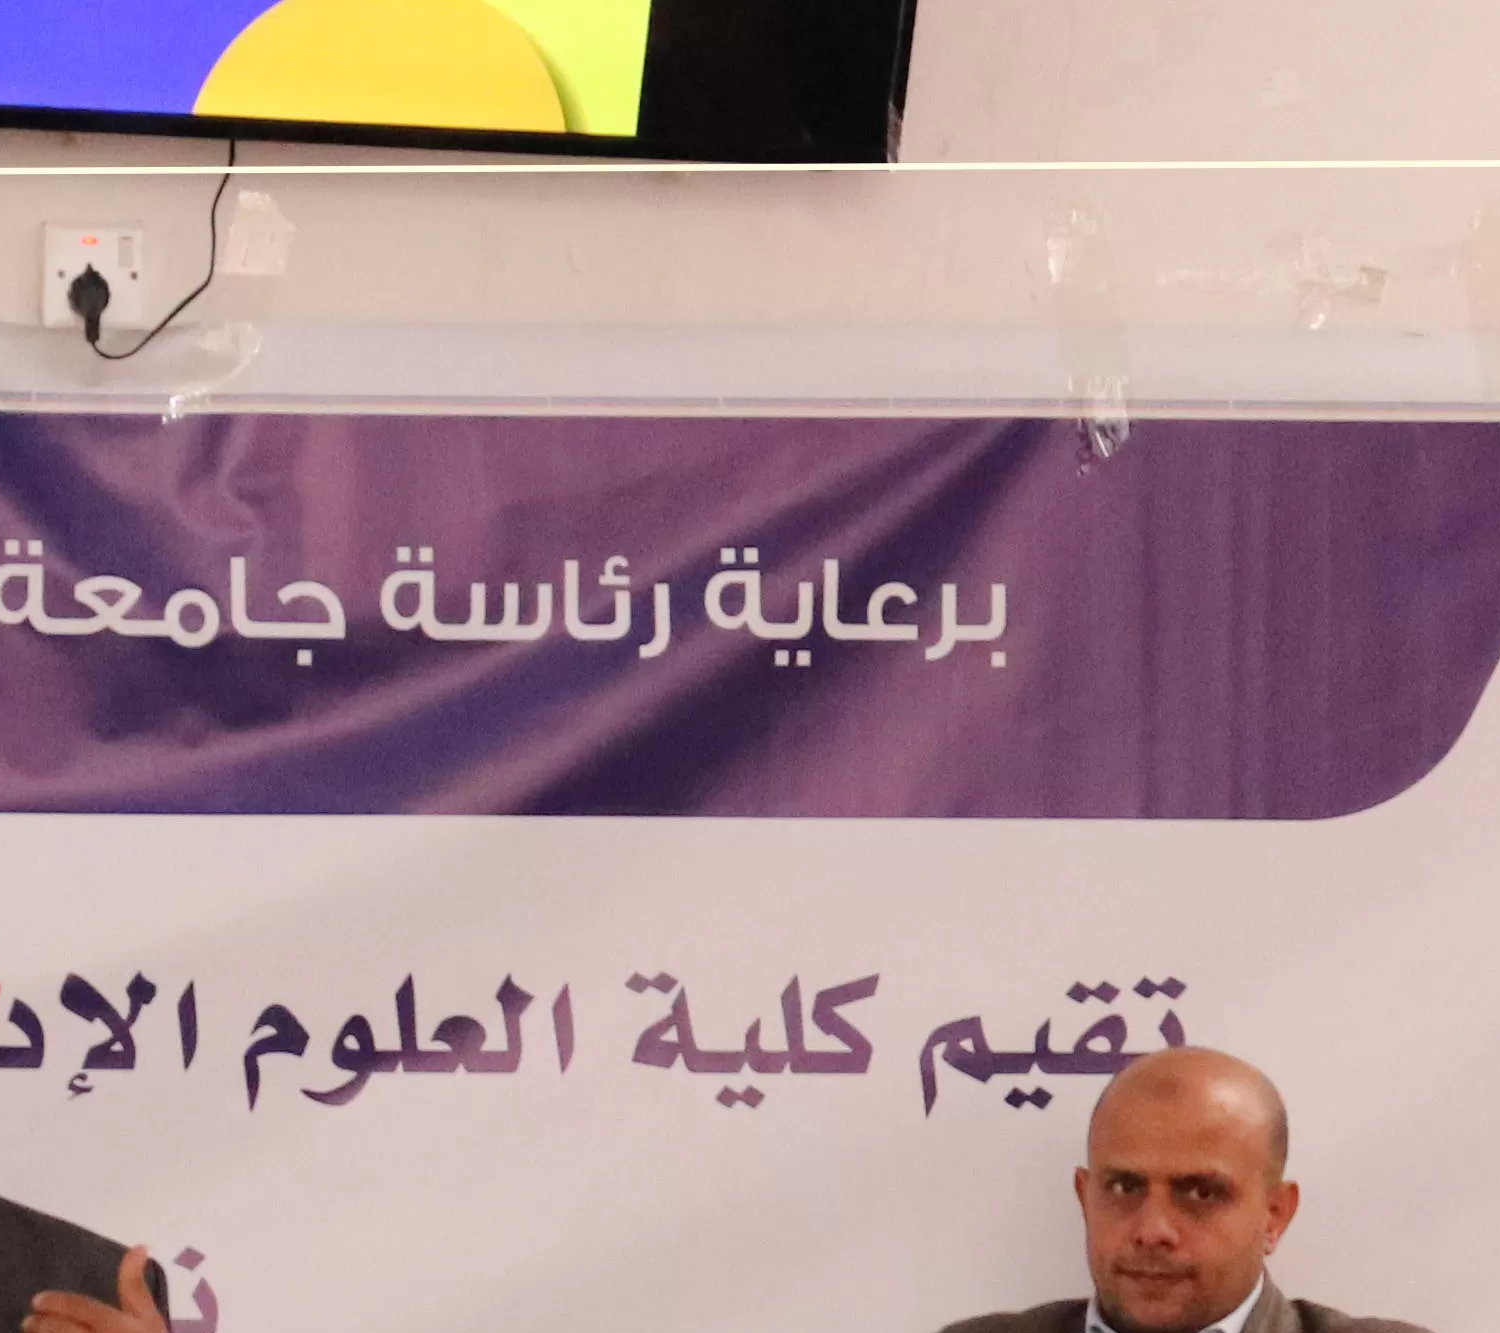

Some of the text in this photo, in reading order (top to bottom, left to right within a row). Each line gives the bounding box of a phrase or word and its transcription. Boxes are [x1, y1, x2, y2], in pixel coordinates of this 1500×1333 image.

[382, 546, 671, 659] رئاسة
[706, 546, 1009, 669] برعاية
[242, 972, 575, 1113] العلوم
[624, 970, 880, 1110] كلية
[919, 975, 1188, 1119] تقيم
